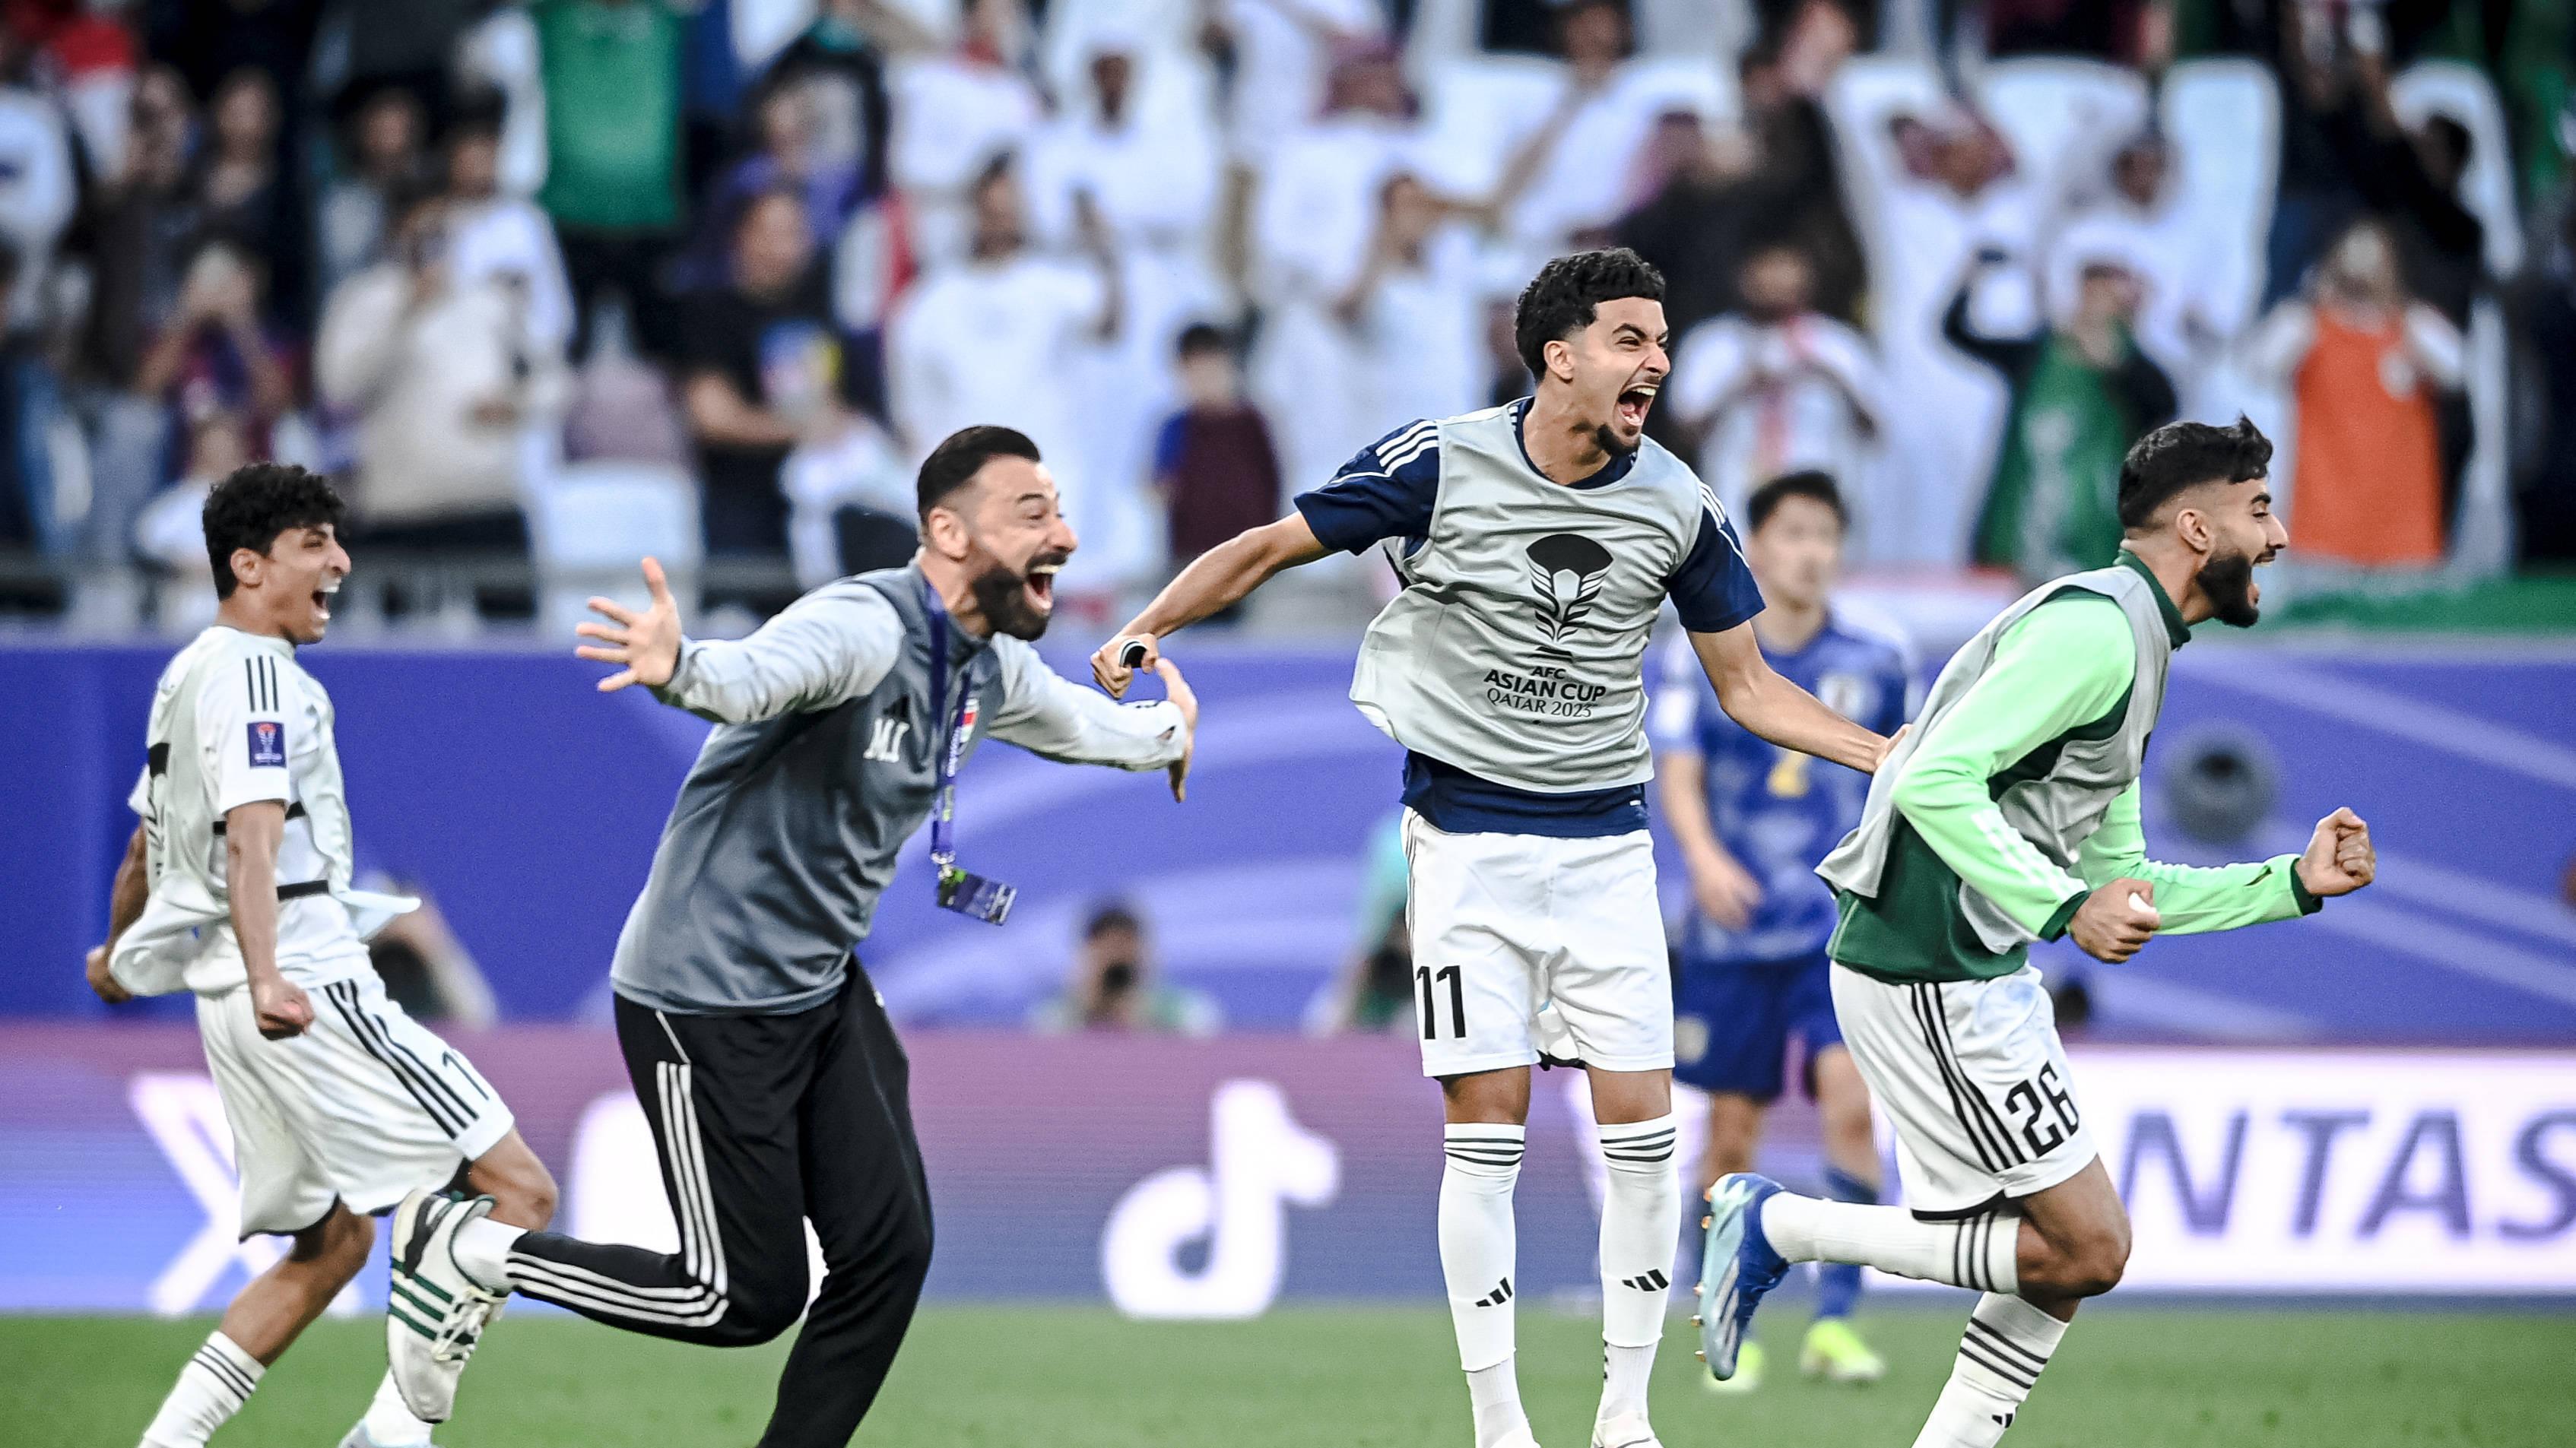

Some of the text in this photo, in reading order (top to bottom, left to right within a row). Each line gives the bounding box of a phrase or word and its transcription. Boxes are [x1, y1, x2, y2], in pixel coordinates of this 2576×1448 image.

[1483, 669, 1607, 702] ASIAN CUP
[1531, 666, 1566, 680] AFC
[1486, 688, 1547, 713] QATAR
[1416, 965, 1466, 1039] 11
[2005, 1060, 2079, 1158] 26
